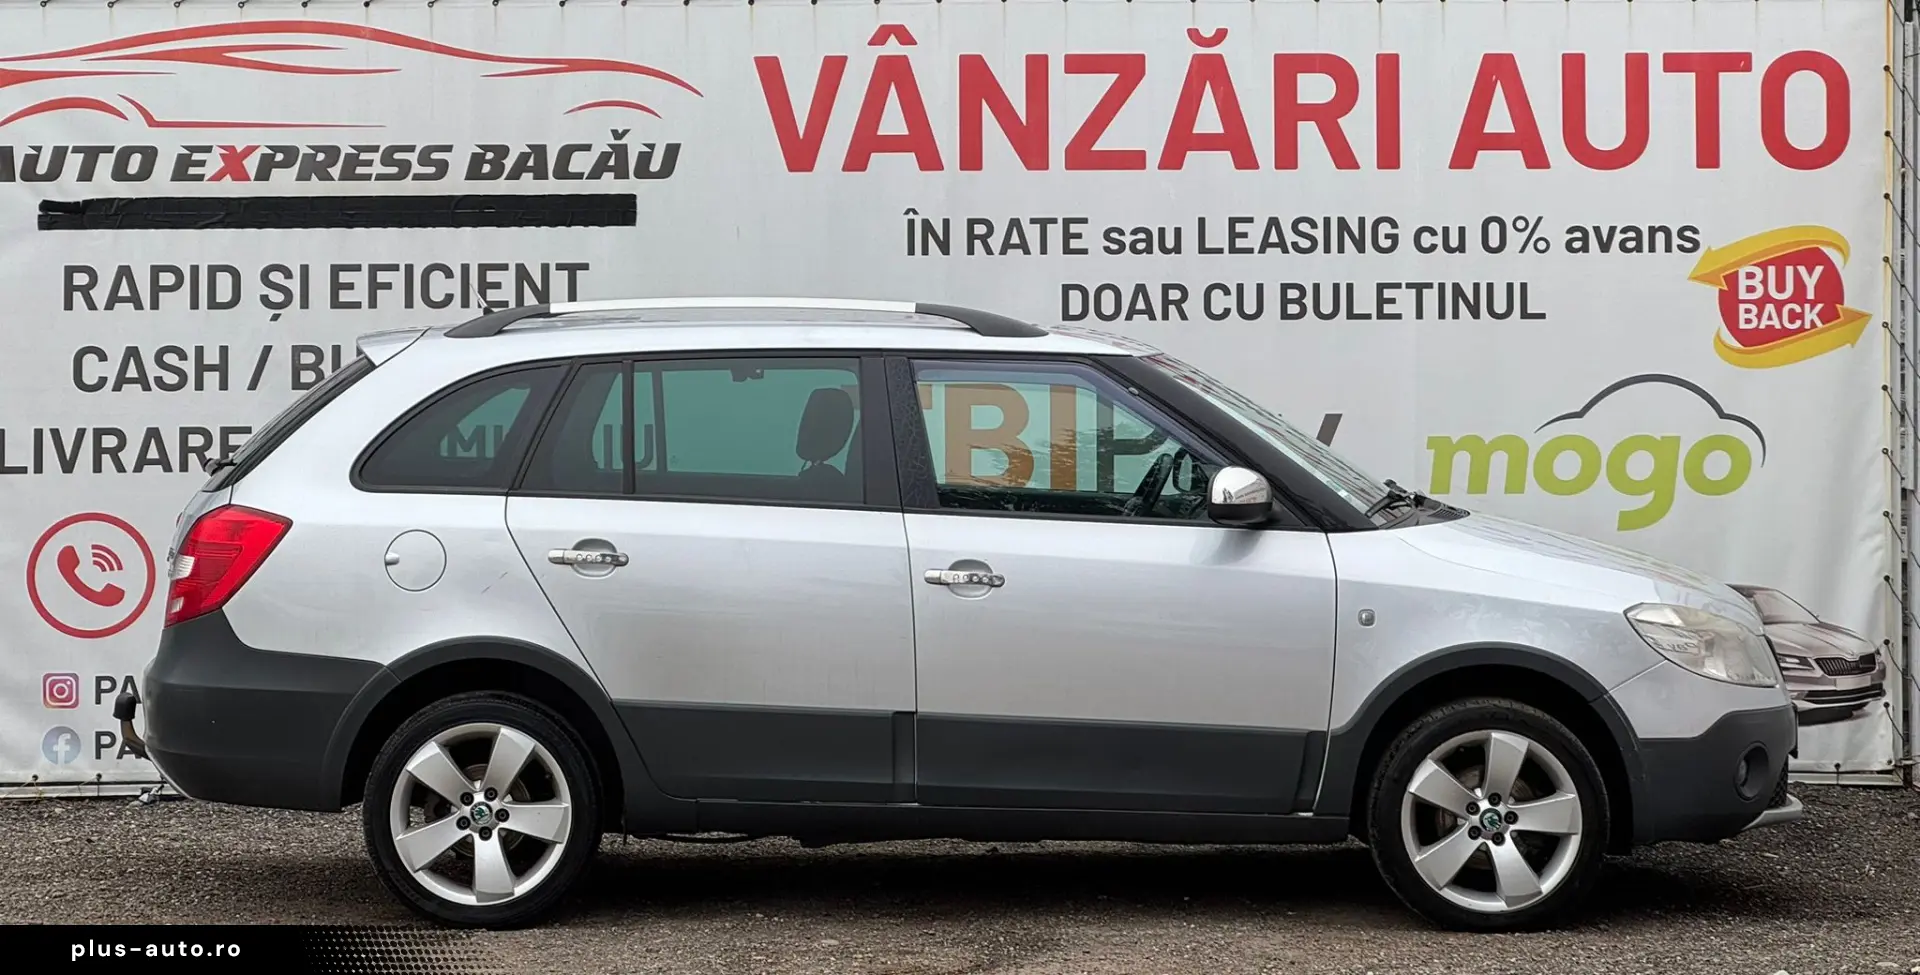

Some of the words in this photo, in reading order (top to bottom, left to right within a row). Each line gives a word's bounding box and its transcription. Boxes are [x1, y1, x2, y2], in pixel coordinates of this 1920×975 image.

[754, 24, 1401, 173] VÂNZĂRI
[1448, 50, 1851, 171] AUTO
[170, 144, 454, 182] EXPRESS
[464, 128, 682, 181] BACĂU
[903, 207, 951, 257] ÎN
[966, 217, 1089, 256] RATE
[1102, 226, 1182, 256] sau
[1197, 216, 1399, 255] LEASING
[1413, 225, 1466, 255] cu
[1481, 215, 1551, 255] 0%
[1564, 224, 1701, 254] avans
[63, 264, 242, 311] RAPID
[259, 263, 310, 322] ȘI
[330, 263, 590, 309] EFICIENT
[1061, 282, 1189, 322] DOAR
[1203, 282, 1265, 322] CU
[1279, 281, 1547, 321] BULETINUL
[1738, 266, 1824, 299] BUY
[1739, 304, 1825, 329] BACK
[72, 345, 229, 393] CASH
[246, 344, 273, 391] /
[1428, 435, 1751, 531] mogo
